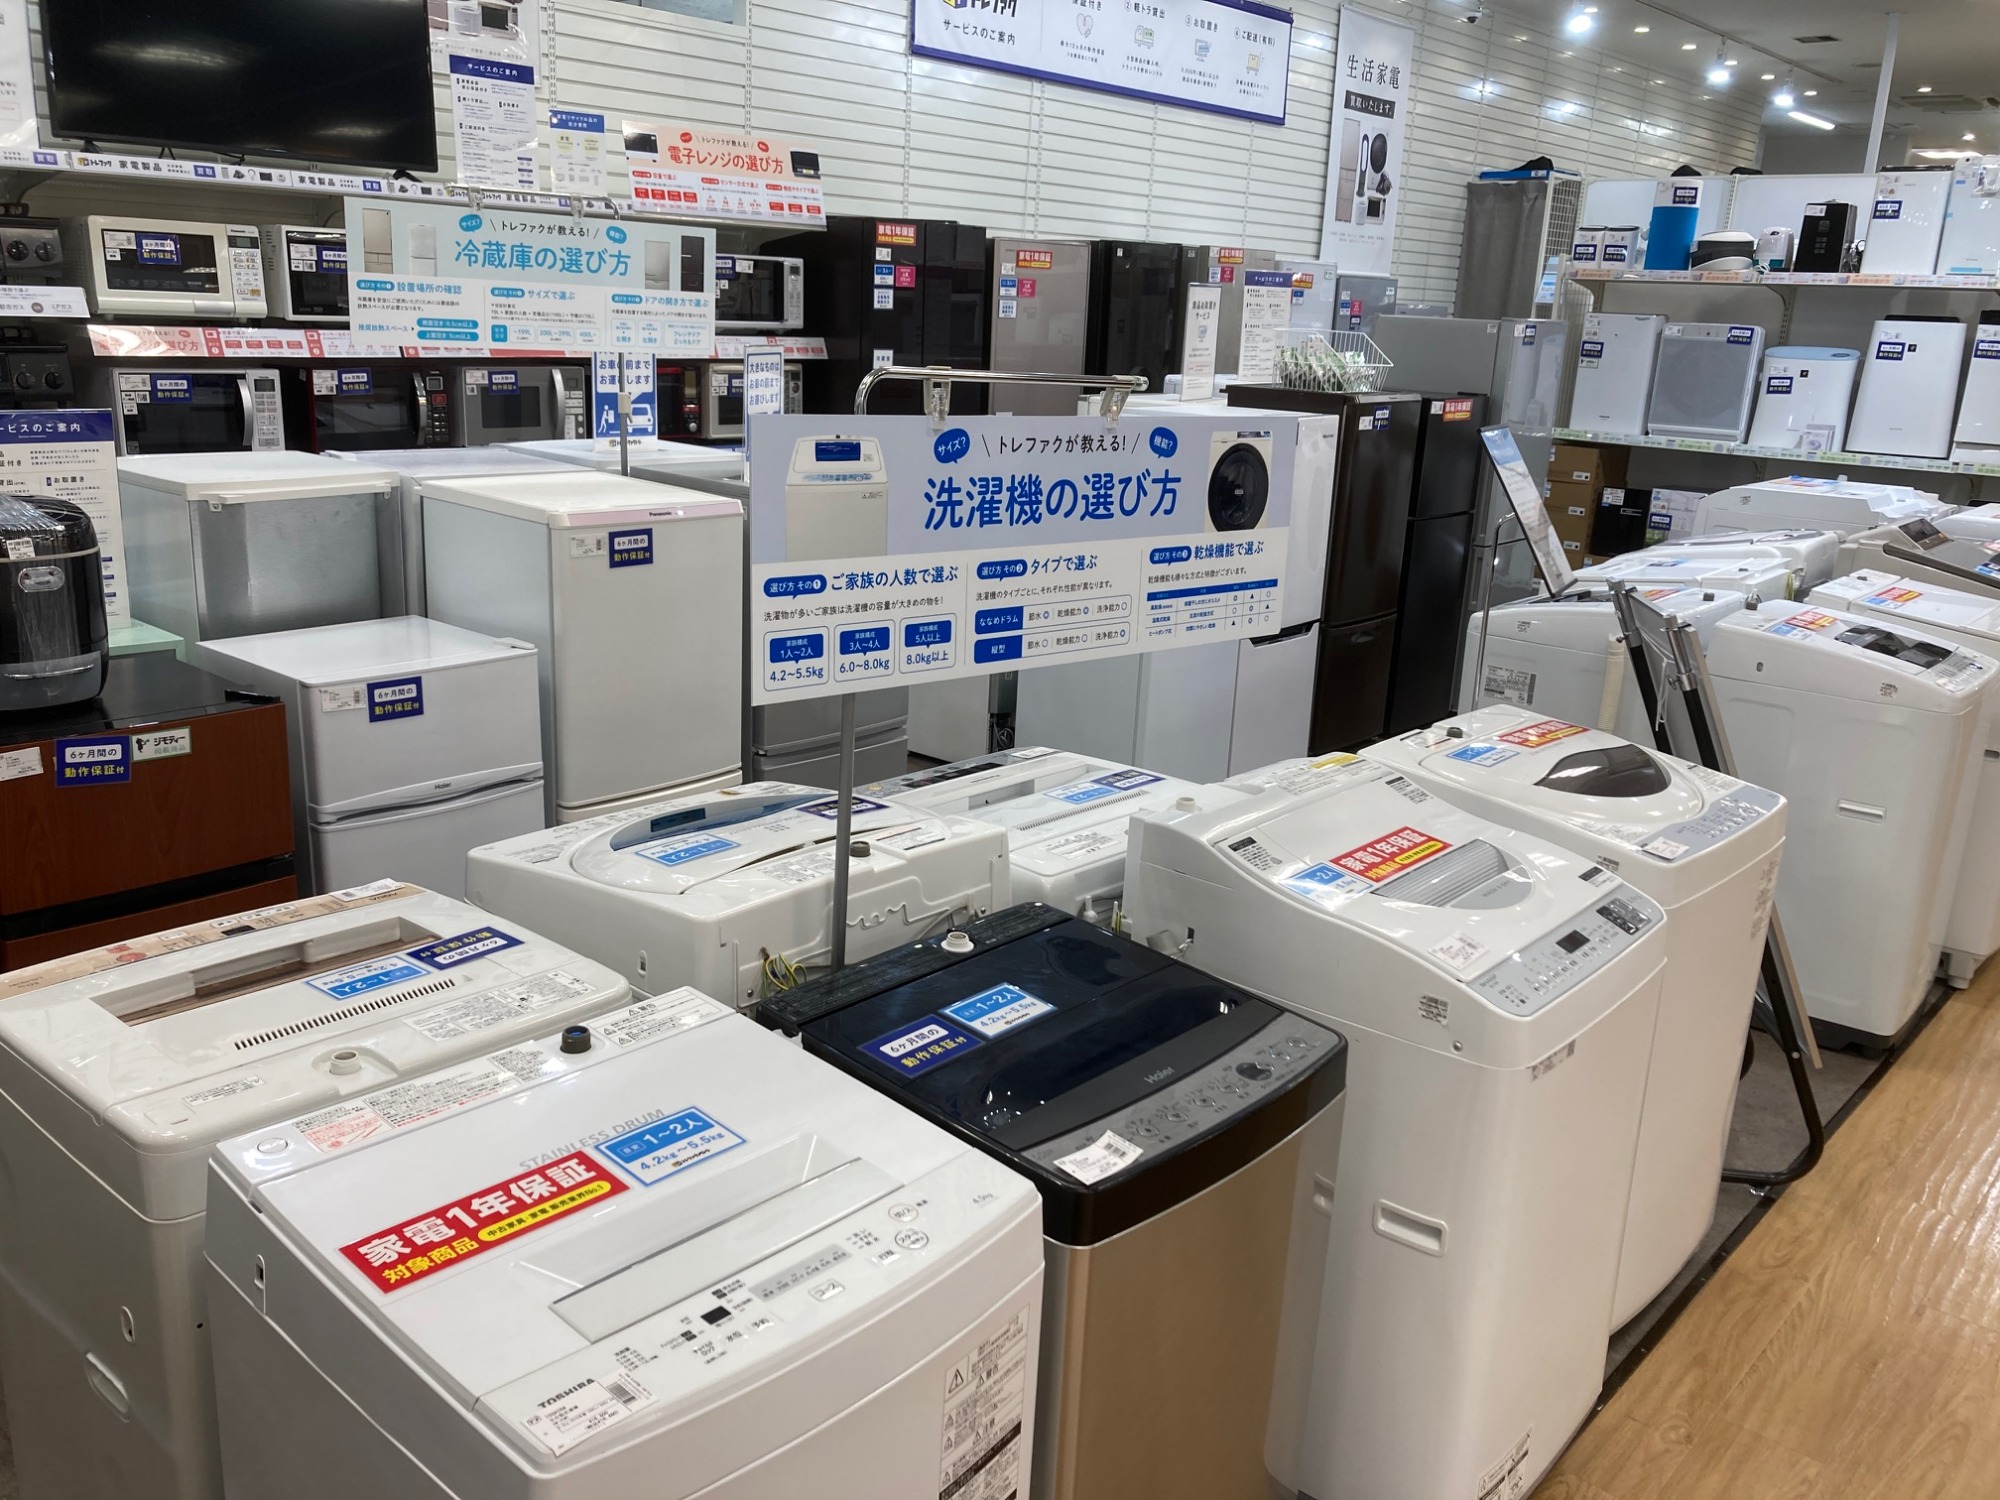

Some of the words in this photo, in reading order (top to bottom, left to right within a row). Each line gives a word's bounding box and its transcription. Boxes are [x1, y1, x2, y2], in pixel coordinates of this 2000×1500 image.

[1134, 3, 1165, 18] 軽トラ貸出
[1194, 18, 1218, 32] お取置き
[944, 19, 1015, 45] サービスのご案内
[468, 63, 518, 77] サービスのご案内
[1347, 54, 1400, 89] 生活家電
[1350, 95, 1392, 115] 買取いたします。
[701, 137, 749, 148] トレファクが教える!
[119, 160, 162, 172] 家電製品
[668, 146, 783, 174] 電子レンジの選び方
[298, 175, 335, 187] 家電製品
[461, 219, 480, 228] サイズ?
[501, 220, 590, 238] トレファクが教える!
[878, 225, 914, 236] 家電1年保証
[454, 239, 632, 277] 冷蔵庫の選び方
[1019, 251, 1051, 261] 家電1年保証
[397, 282, 462, 295] 設置場所の確認
[528, 290, 575, 300] サイズで選ぶ
[646, 296, 709, 307] ドアの開き方で選ぶ
[750, 362, 780, 372] 大きなものは
[600, 376, 651, 385] お運します
[0, 423, 81, 433] ービスのご案内
[936, 436, 967, 456] サイズ?
[1000, 434, 1126, 454] トレファクが教える!
[1154, 434, 1174, 451] 機能?
[923, 468, 1182, 531] 洗濯機の選び方
[617, 538, 645, 547] 6ヶ月間の
[614, 551, 650, 562] 動作保証付
[1194, 541, 1264, 560] 乾燥機能で選ぶ
[982, 565, 1002, 576] 選び方
[1031, 555, 1098, 575] タイプで選ぶ
[831, 566, 959, 591] ご家族の人数で選ぶ
[769, 582, 795, 593] 選び方
[976, 580, 1112, 601] 洗濯機のタイプごとに、それぞれ性能が異なります。
[764, 596, 943, 622] 洗濯物が多いご家族は洗濯機の容量が大きめの物を!
[1057, 608, 1082, 618] 乾燥能力
[1097, 603, 1120, 613] 洗浄能力
[979, 616, 1019, 626] ななめドラム
[1028, 612, 1041, 621] 節水
[915, 634, 941, 643] 5人以上
[1056, 635, 1080, 646] 乾燥能力
[1095, 631, 1119, 641] 洗浄能力
[1028, 640, 1041, 649] 節水
[906, 651, 949, 666] 8.0kg以上
[378, 688, 414, 699] 6ヶ月間の
[374, 701, 420, 715] 動作保証付
[153, 736, 186, 746] ジモティー
[70, 748, 117, 759] 6ヶ月間の
[64, 766, 124, 778] 動作保証付
[434, 781, 452, 791] Haier
[1338, 829, 1428, 872] 家電1年保証
[890, 1027, 940, 1053] 6ヶ月間の
[901, 1036, 967, 1068] 動作保証付
[1143, 1065, 1176, 1084] Haier
[519, 1130, 611, 1172] STAINLESS
[611, 1107, 666, 1136] DRUM
[356, 1157, 598, 1269] 家電1年保証
[380, 1237, 480, 1286] 対象商品
[537, 1378, 596, 1409] TOSHIBA
